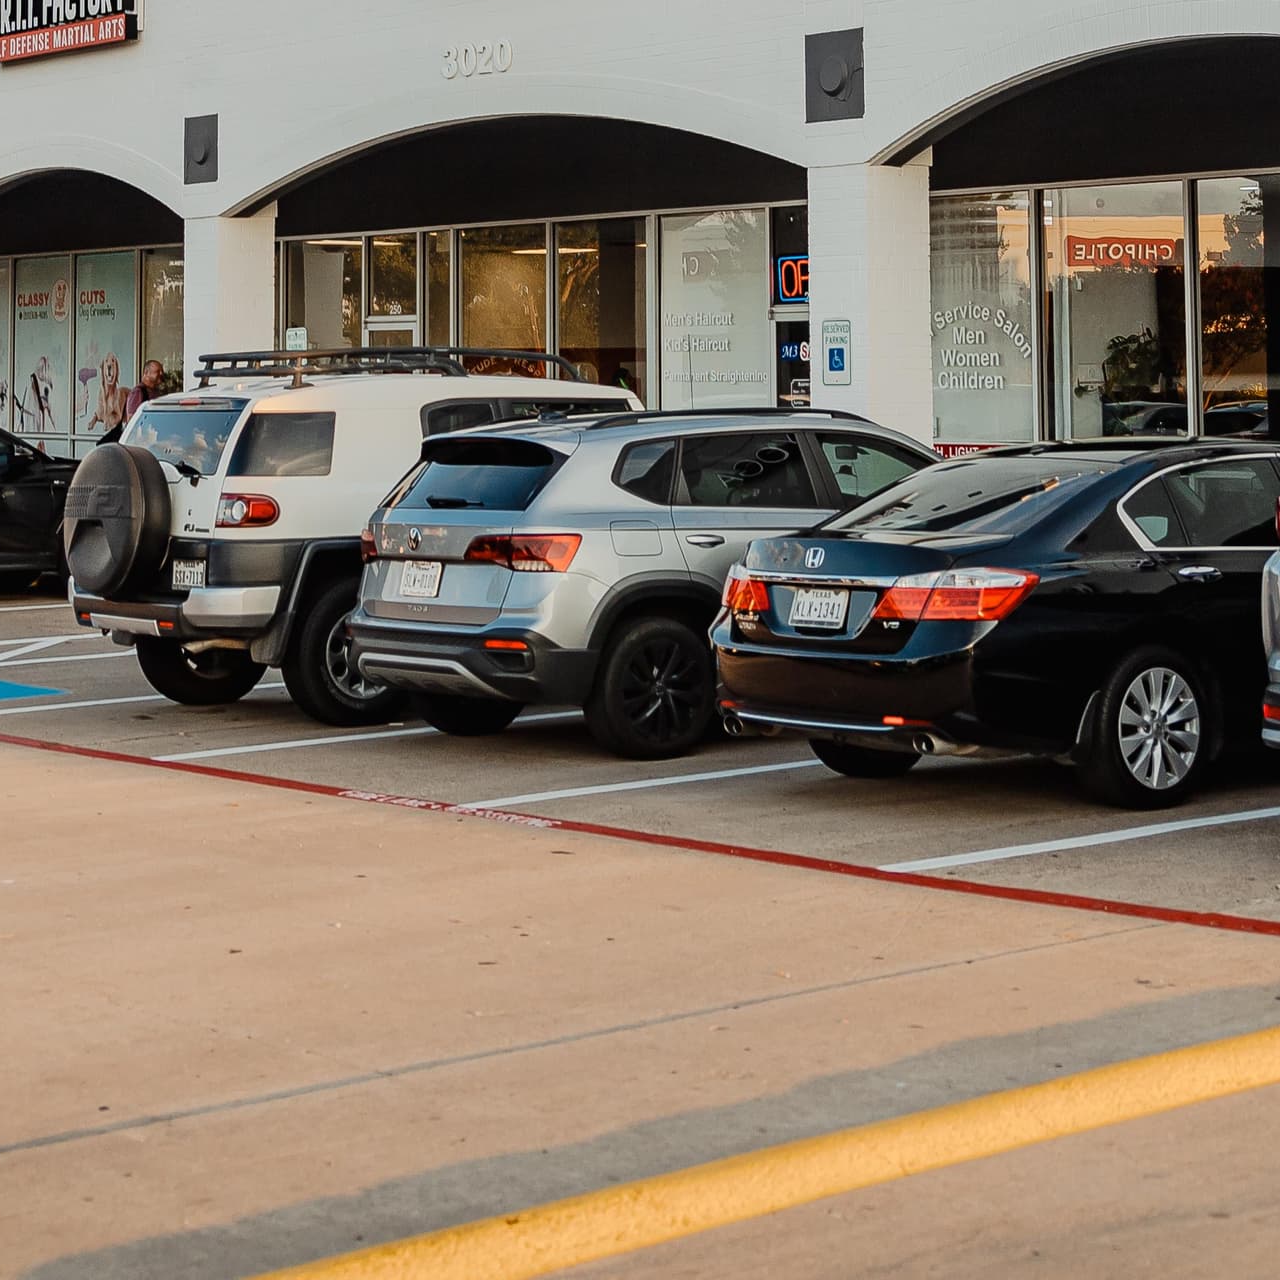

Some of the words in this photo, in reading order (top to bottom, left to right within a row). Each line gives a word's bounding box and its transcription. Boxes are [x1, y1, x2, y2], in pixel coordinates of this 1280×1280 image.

[10, 36, 49, 56] DEFENSE
[53, 27, 95, 49] MARTIAL
[99, 18, 124, 39] ARTS
[440, 39, 513, 79] 3020
[781, 260, 810, 297] OP
[17, 292, 49, 307] CLASSY
[80, 289, 105, 305] CUTS
[389, 303, 402, 315] 250
[695, 311, 734, 326] Haircut
[933, 301, 991, 331] Service
[993, 308, 1032, 360] Salon
[952, 327, 986, 345] Men
[692, 337, 731, 352] Haircut
[941, 349, 1000, 367] Women
[710, 369, 769, 385] Straightening
[938, 371, 1005, 390] Children
[812, 591, 831, 599] TEXAS
